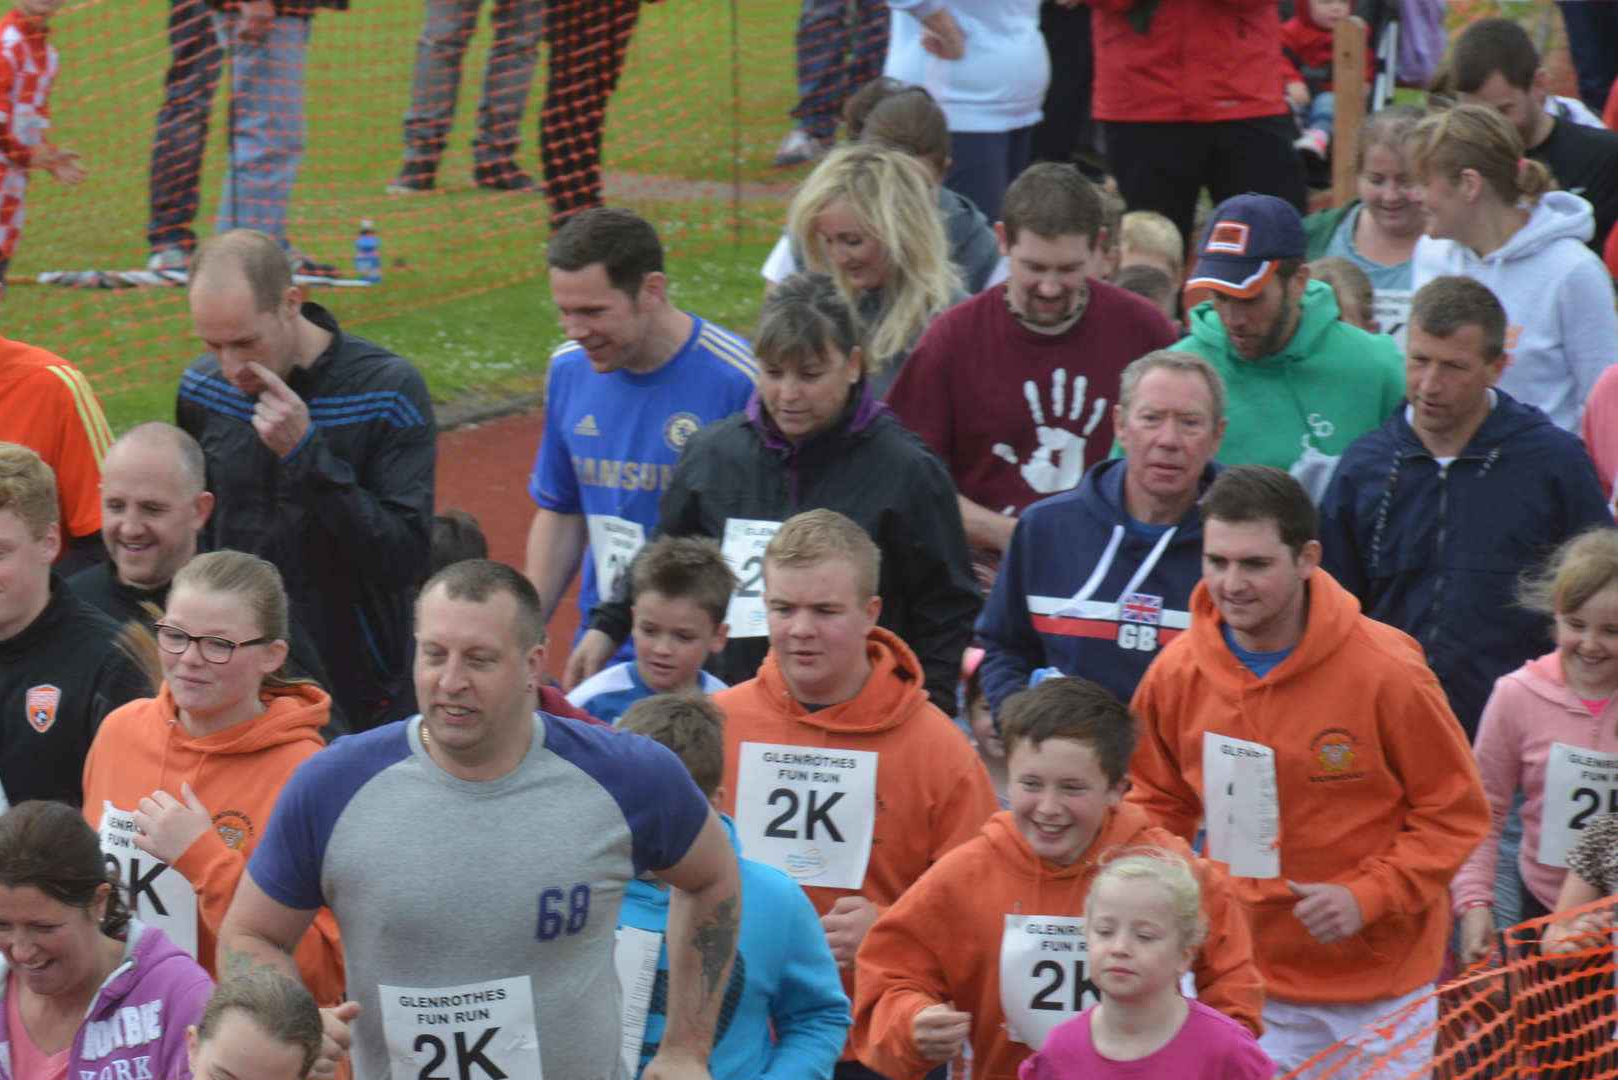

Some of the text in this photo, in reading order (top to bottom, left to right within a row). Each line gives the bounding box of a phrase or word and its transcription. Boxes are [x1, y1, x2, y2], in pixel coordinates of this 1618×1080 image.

[736, 555, 765, 598] 2
[1116, 623, 1158, 652] GB
[762, 751, 858, 770] GLENROTHES
[778, 768, 842, 784] FUN RUN
[762, 787, 849, 843] 2K
[1567, 787, 1618, 831] 2
[534, 881, 593, 944] 68
[1041, 940, 1074, 952] FUN
[398, 987, 507, 1010] GLENROTHES
[416, 1007, 491, 1026] FUN RUN
